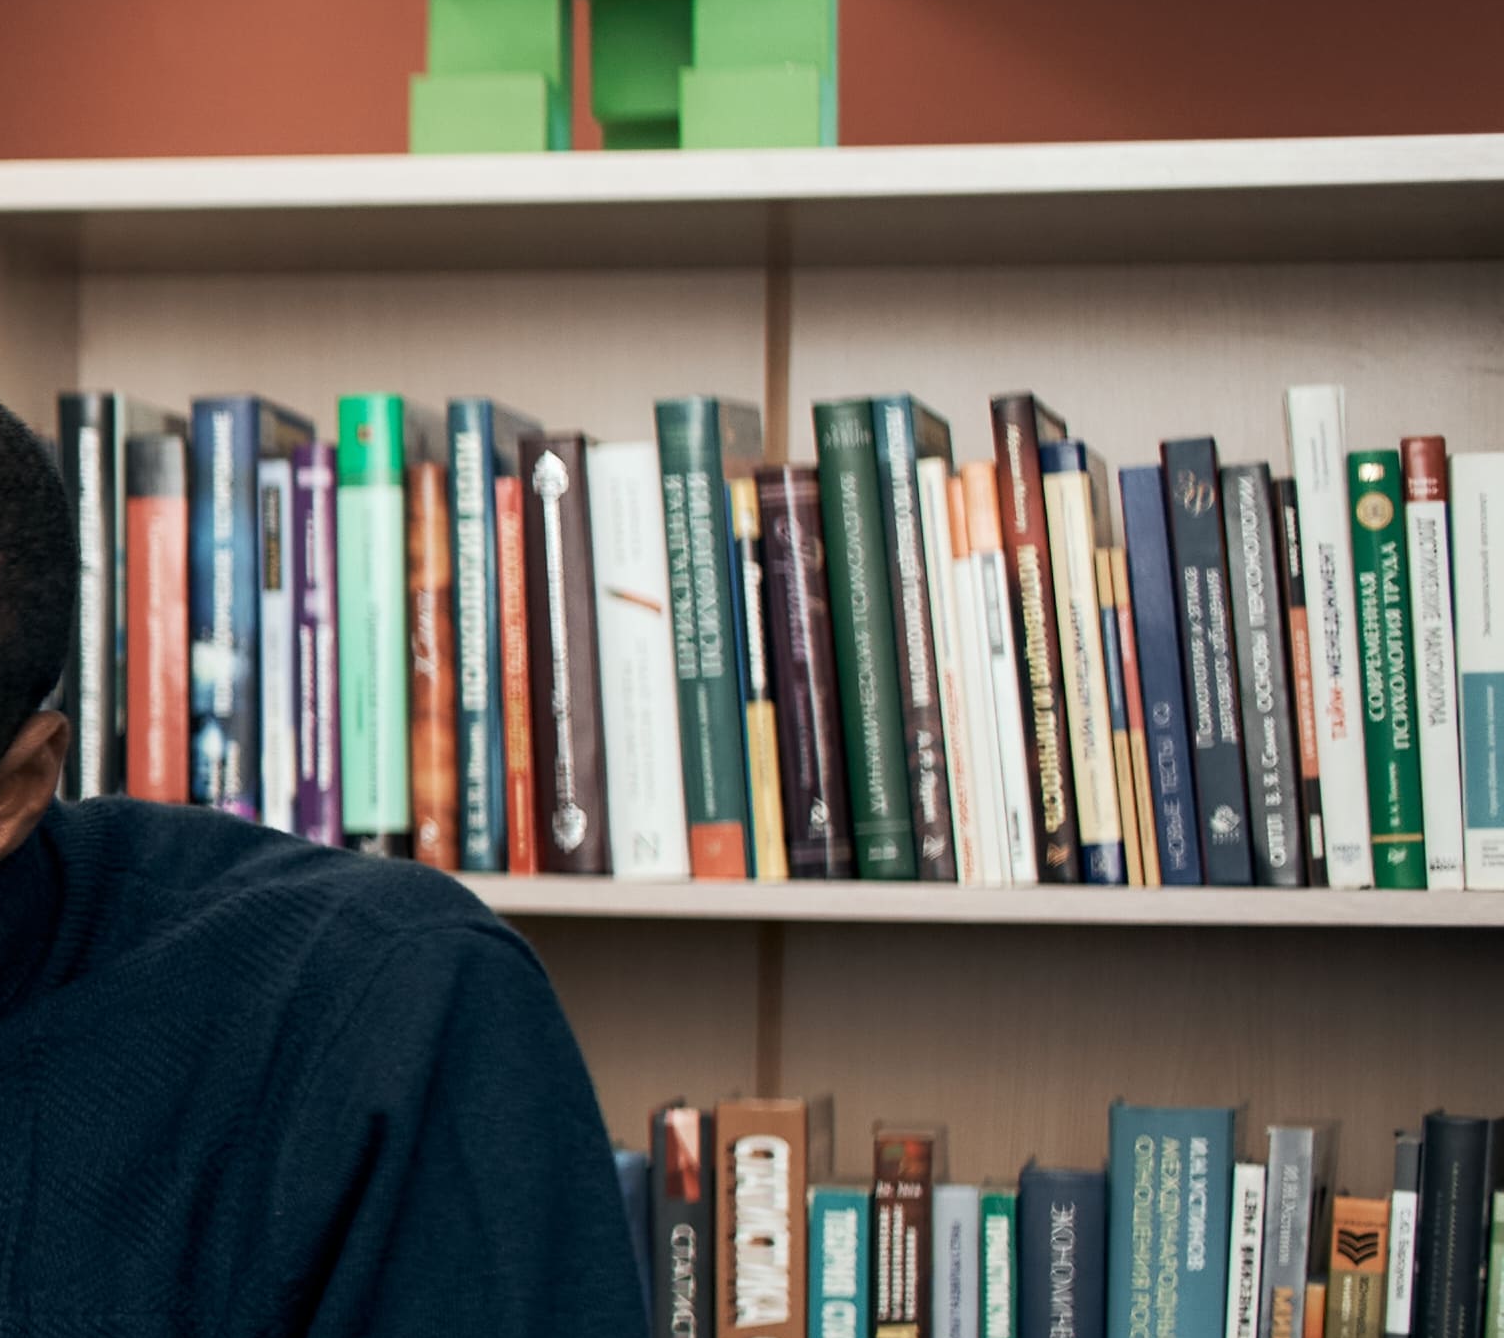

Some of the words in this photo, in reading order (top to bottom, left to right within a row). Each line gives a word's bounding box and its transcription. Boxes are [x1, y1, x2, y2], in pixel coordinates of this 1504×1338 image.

[686, 472, 723, 678] ПСИХОЛОГИЯ
[840, 472, 867, 622] ПСИХОЛОГИЯ
[1381, 541, 1401, 605] ТРУДА
[1190, 637, 1214, 749] ПСИХОЛОГИЯ
[1319, 542, 1347, 741] ТАЙМ-МЕНЕДЖМЕНТ
[1359, 571, 1386, 722] СОВРЕМЕННАЯ
[1386, 608, 1410, 750] ПСИХОЛОГИЯ
[734, 1135, 791, 1329] СТАТИСТИКА
[823, 1208, 858, 1298] ТЕОРИЯ
[1131, 1134, 1156, 1289] ОТНОШЕНИЯ
[1243, 1189, 1258, 1238] УЧЕТ
